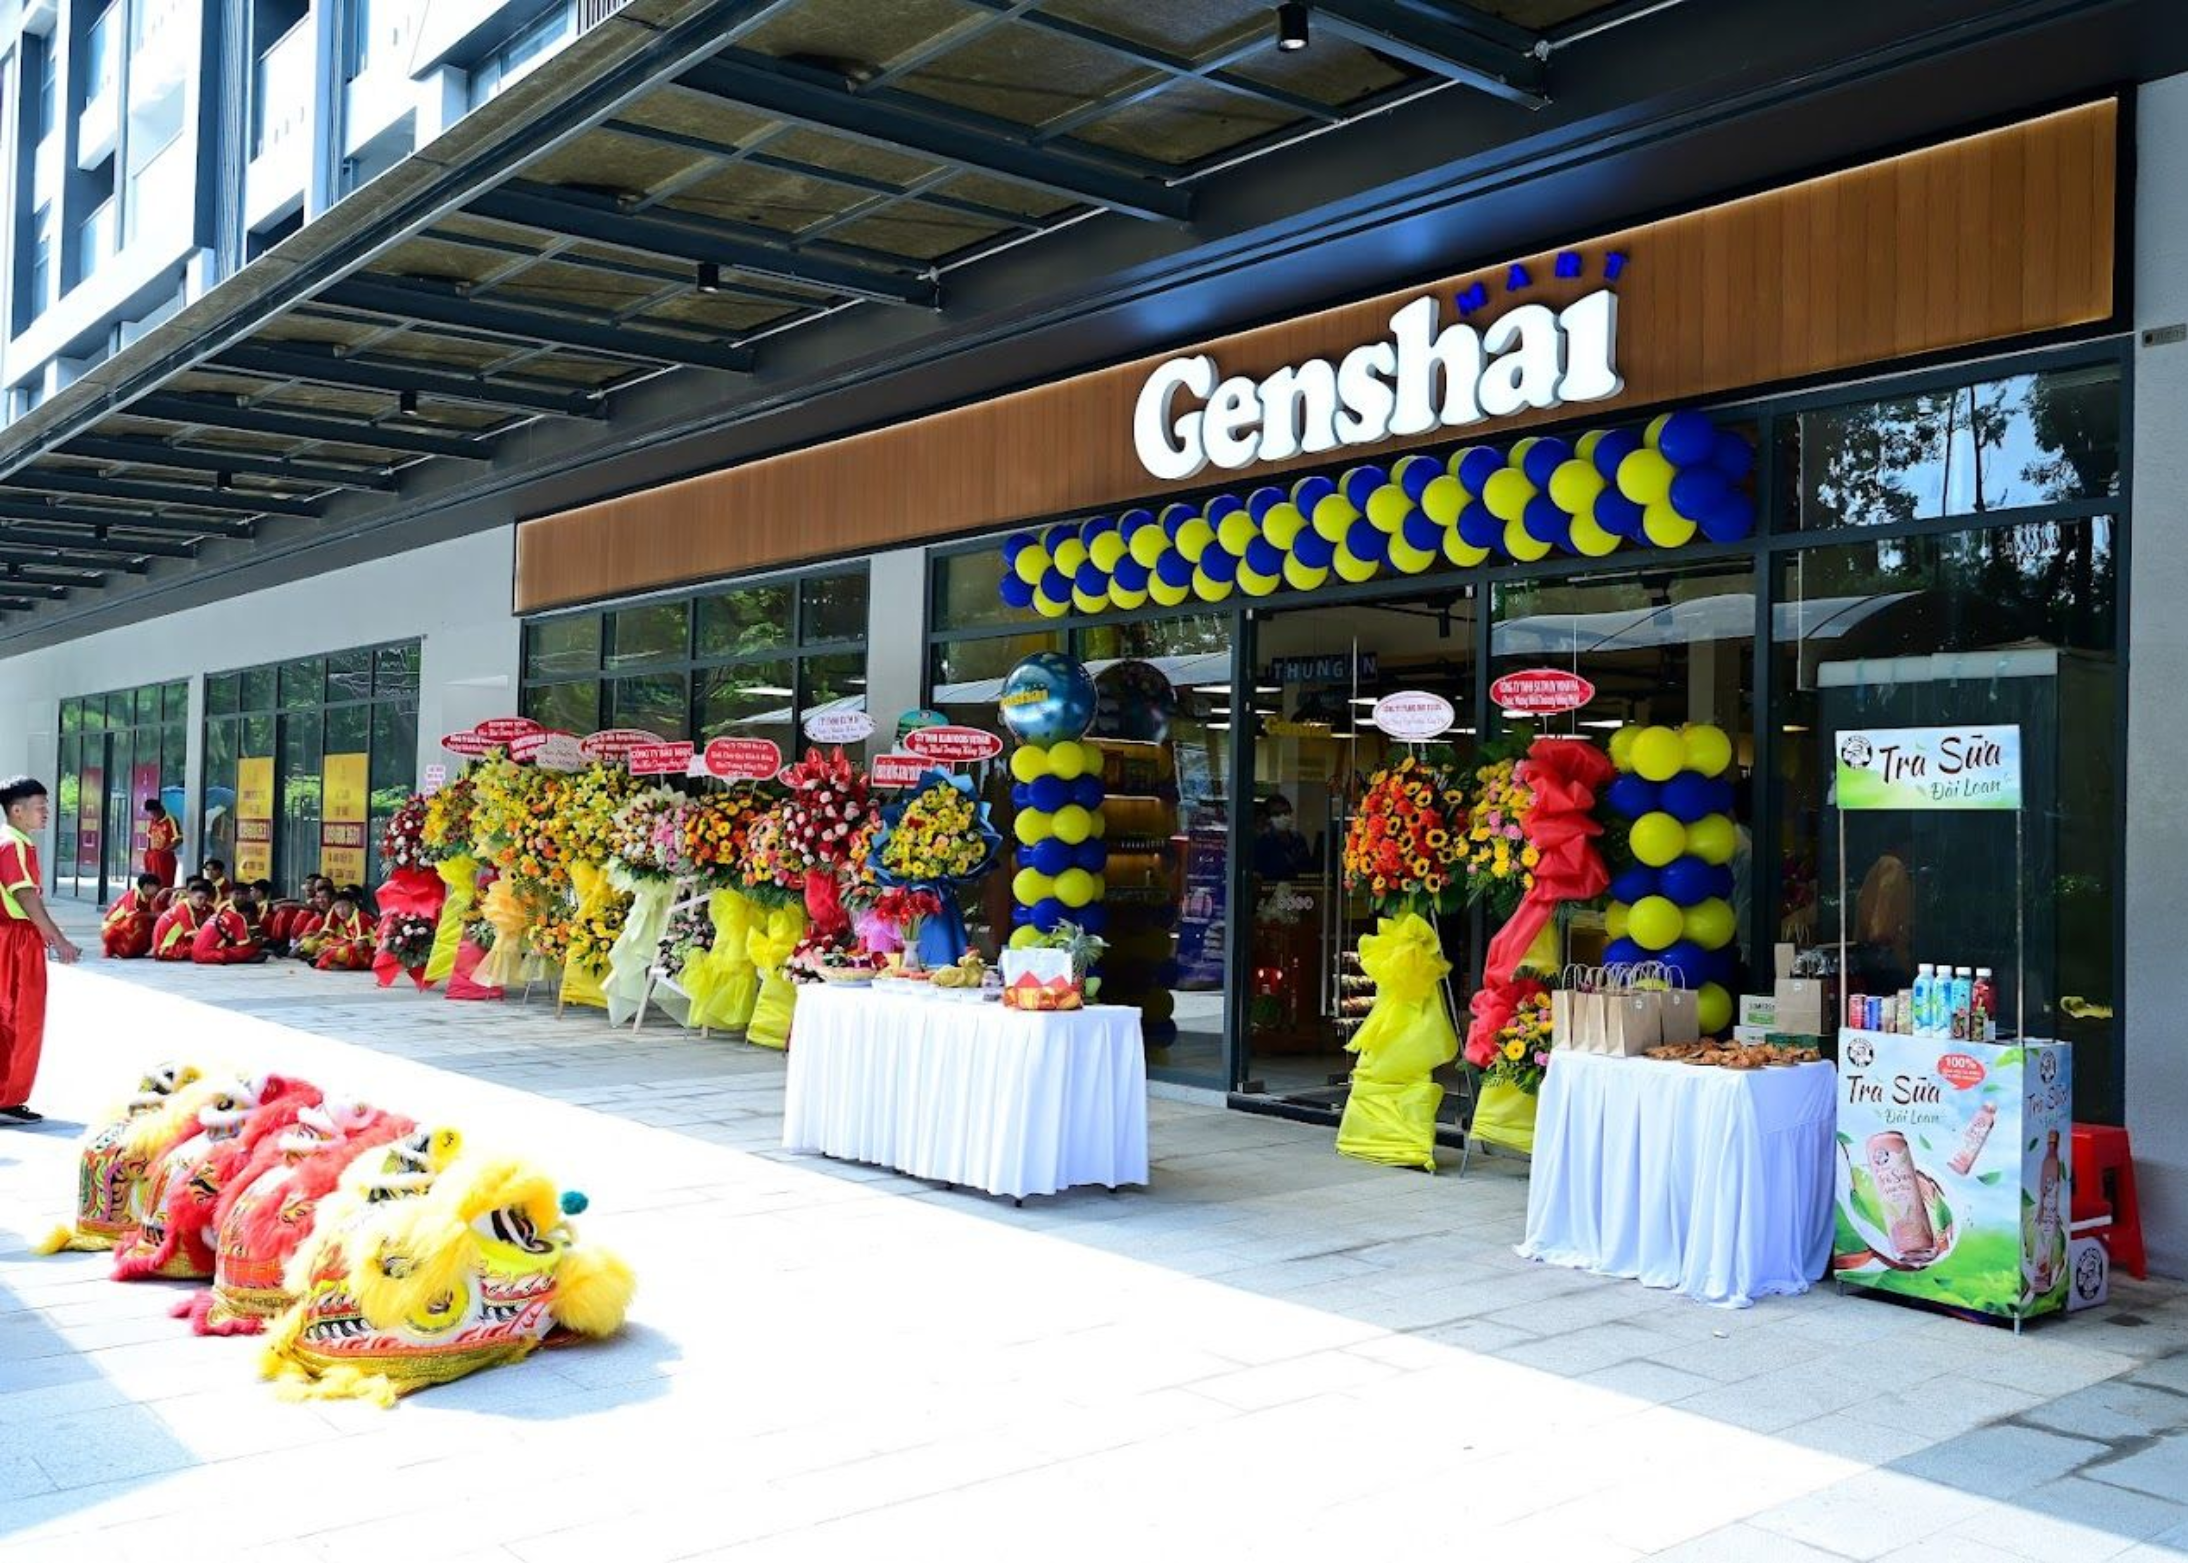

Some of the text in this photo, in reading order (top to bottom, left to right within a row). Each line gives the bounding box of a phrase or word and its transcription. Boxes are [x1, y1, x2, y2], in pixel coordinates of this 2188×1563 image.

[1455, 250, 1629, 316] MART
[1133, 289, 1625, 480] Genshai
[1879, 740, 1926, 784] Trà
[1938, 733, 2001, 775] Sữa
[1963, 777, 2001, 798] Loan
[1945, 1055, 1978, 1070] 100%
[1847, 1074, 1940, 1105] Trà Sữa
